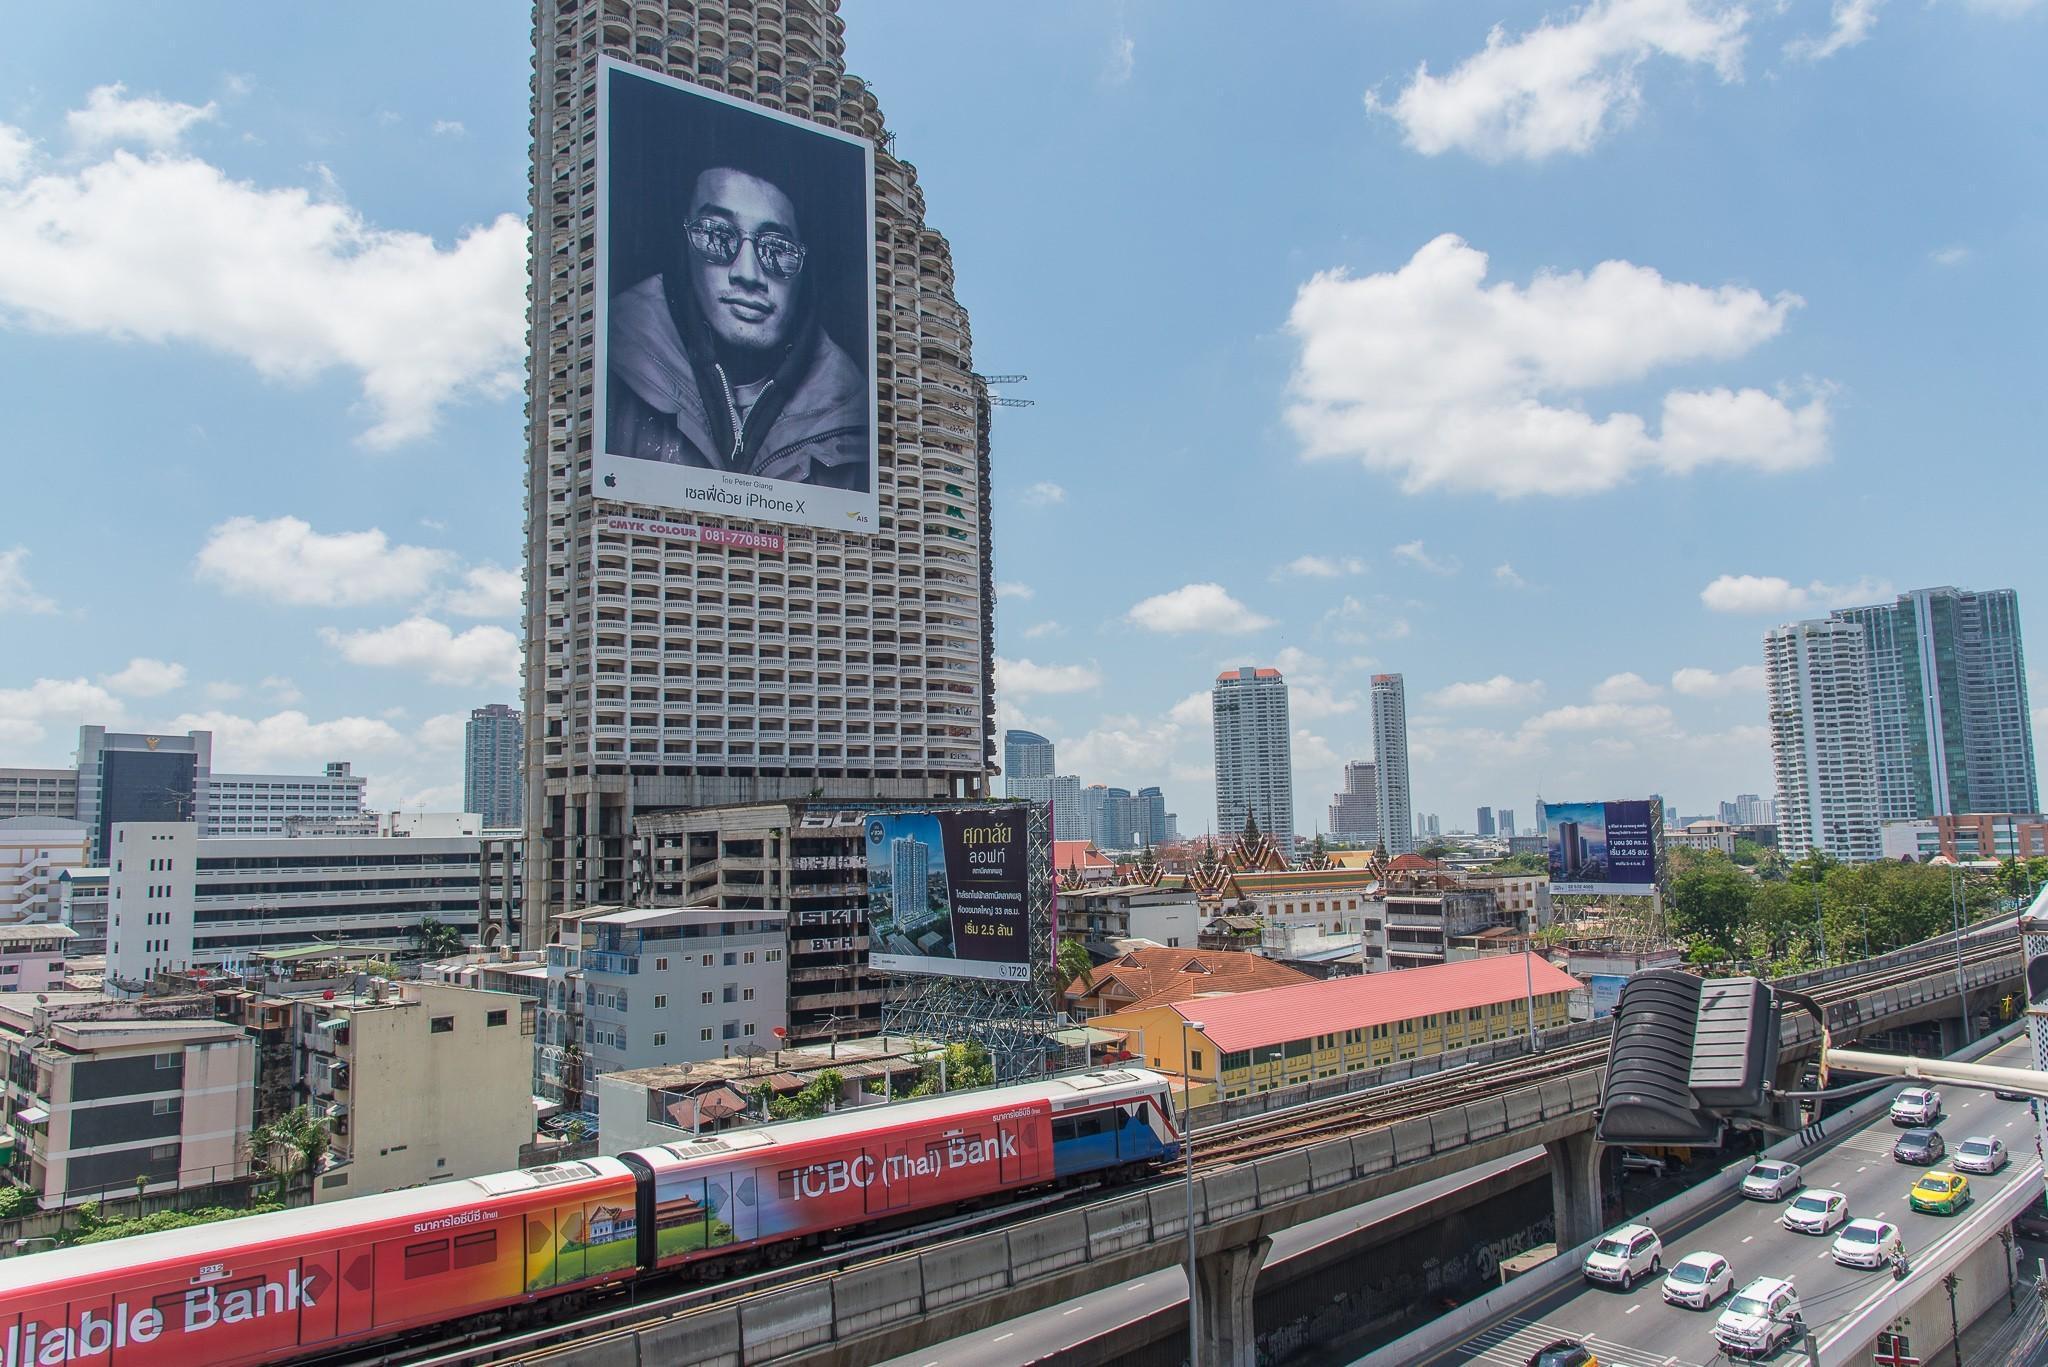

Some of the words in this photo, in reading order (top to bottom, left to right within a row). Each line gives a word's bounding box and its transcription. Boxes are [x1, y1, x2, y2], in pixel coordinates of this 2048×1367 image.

[734, 478, 751, 487] Peter
[753, 480, 773, 491] Giang
[685, 485, 742, 505] เซลฟี่ด้วย
[746, 493, 793, 512] iPhone
[795, 500, 806, 514] X
[856, 515, 869, 523] AIS
[608, 520, 645, 531] CMYK
[649, 524, 697, 538] COLOUR
[704, 529, 779, 549] 081-7708518
[962, 822, 1012, 848] ศุภาลัย
[969, 848, 1005, 863] ลอฟท์
[994, 907, 1003, 915] 33
[964, 919, 978, 935] เริ่ม
[981, 924, 995, 936] 2.5
[997, 924, 1013, 936] ล้าน
[811, 937, 854, 952] BTH
[1008, 966, 1028, 977] 1720
[792, 1155, 875, 1201] ICBC
[881, 1150, 942, 1187] (Thai)
[948, 1129, 1018, 1168] Bank
[414, 1209, 481, 1233] ธนาคารไอซีบีซี
[482, 1211, 498, 1221] (ไทย)
[200, 1264, 223, 1274] 3212
[0, 1301, 164, 1367] liable
[184, 1268, 317, 1333] Bank
